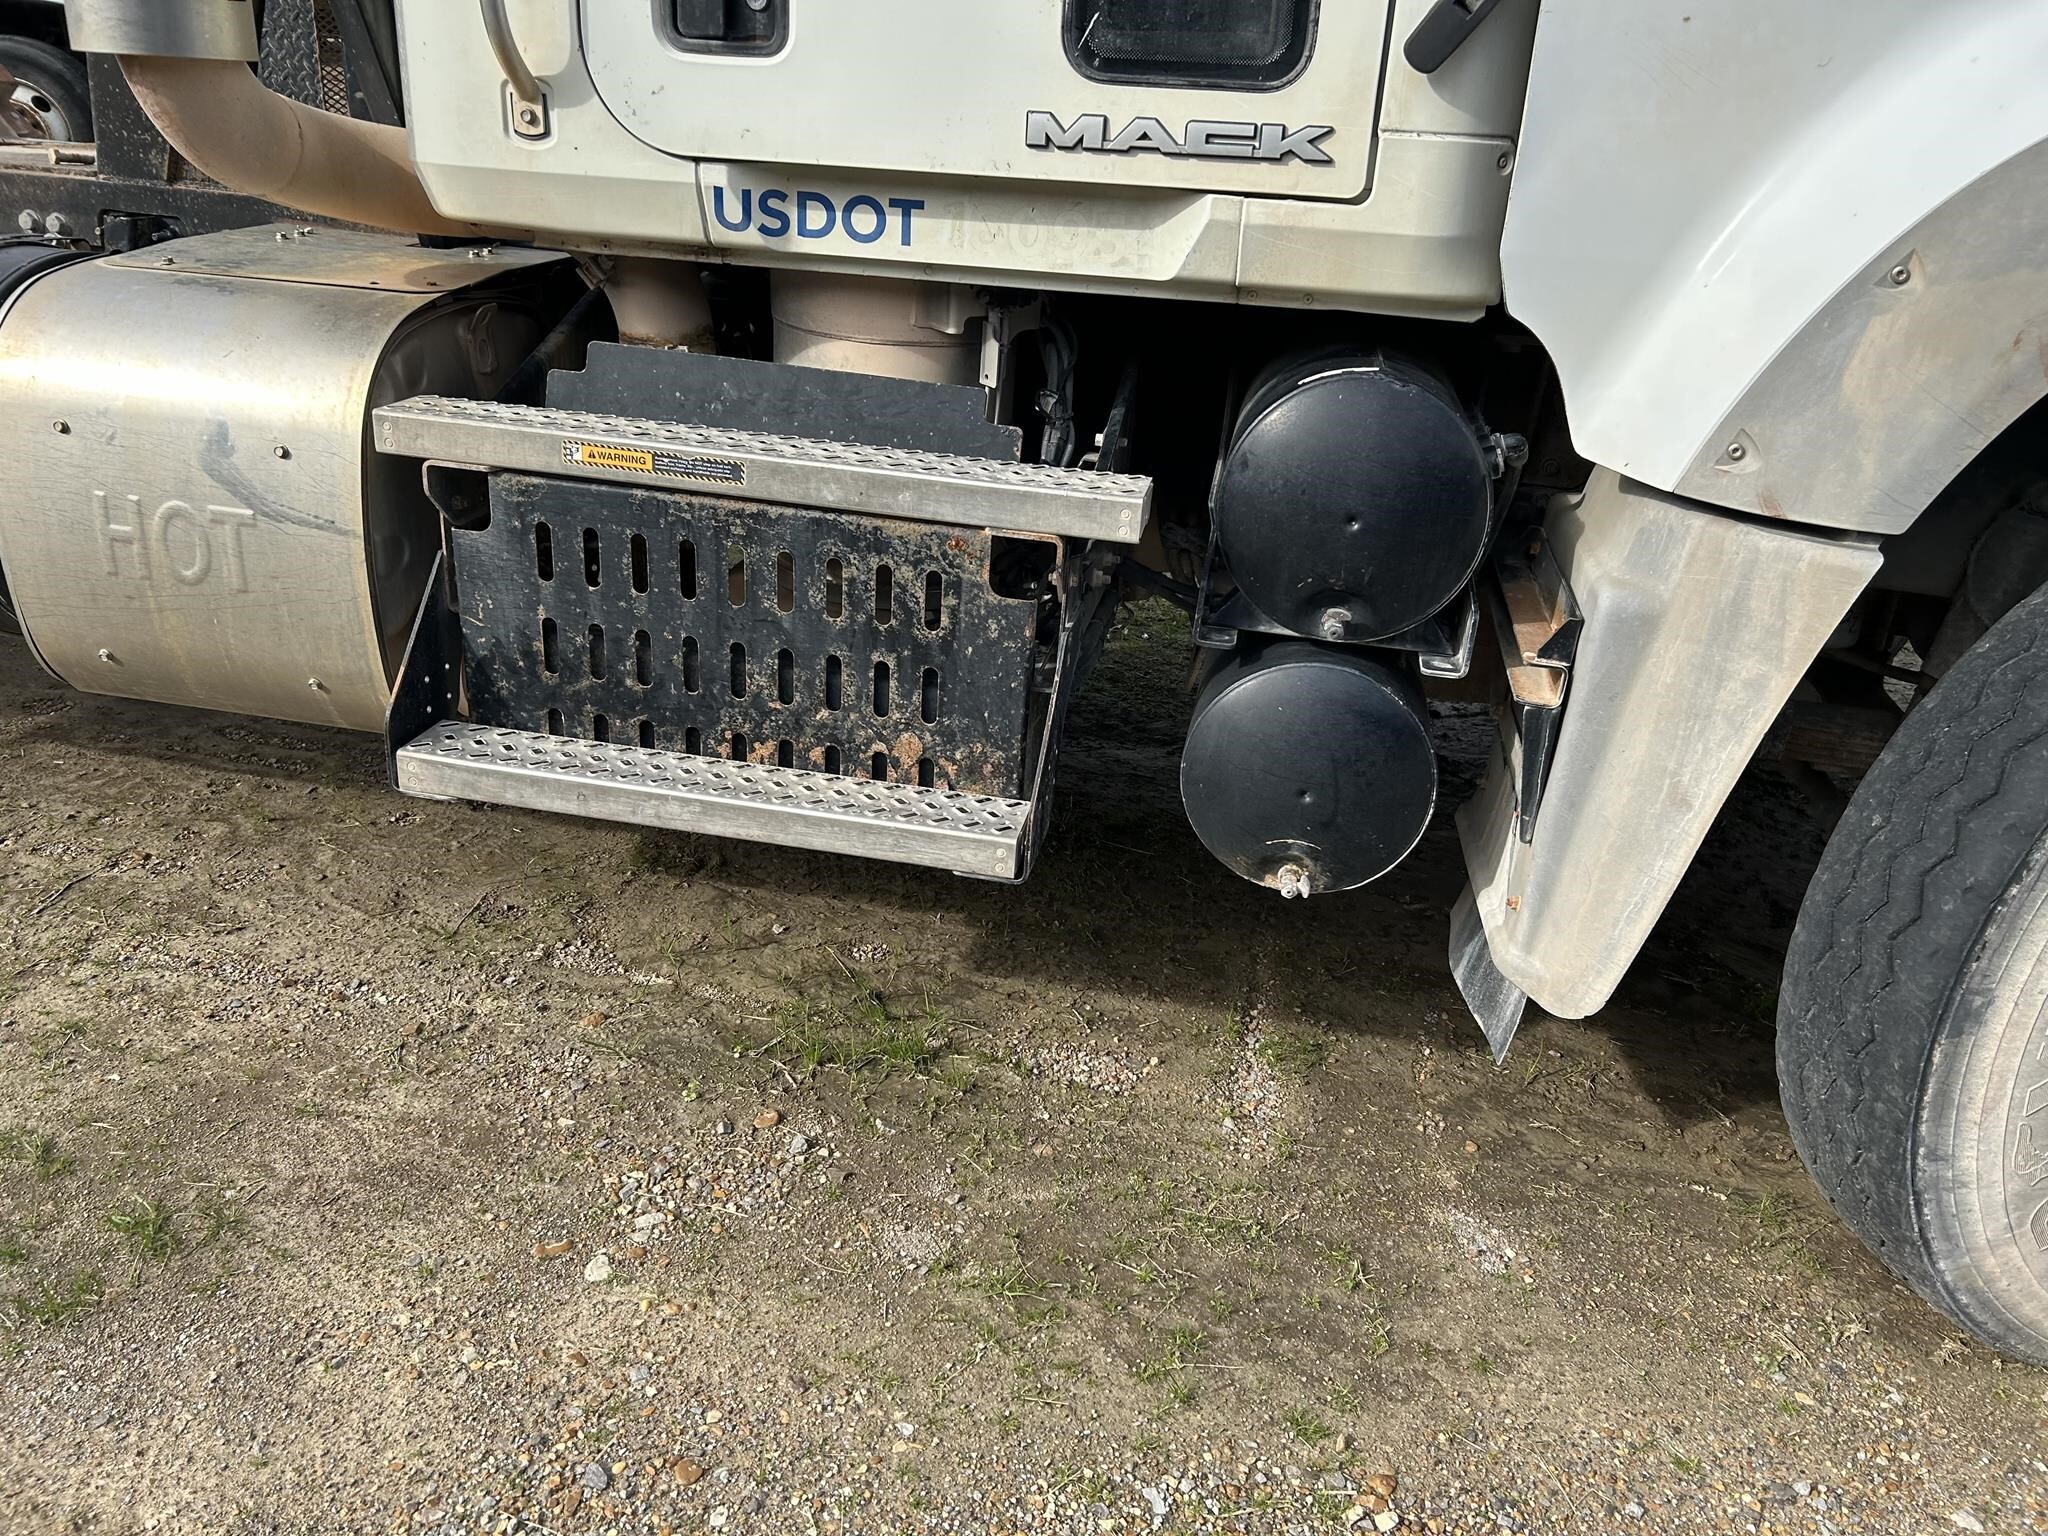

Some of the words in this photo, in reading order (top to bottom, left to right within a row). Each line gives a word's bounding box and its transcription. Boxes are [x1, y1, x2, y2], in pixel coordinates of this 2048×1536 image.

[1026, 110, 1334, 164] MACK
[712, 185, 925, 247] USDOT
[597, 452, 647, 465] WARNING
[93, 490, 258, 593] HOT
